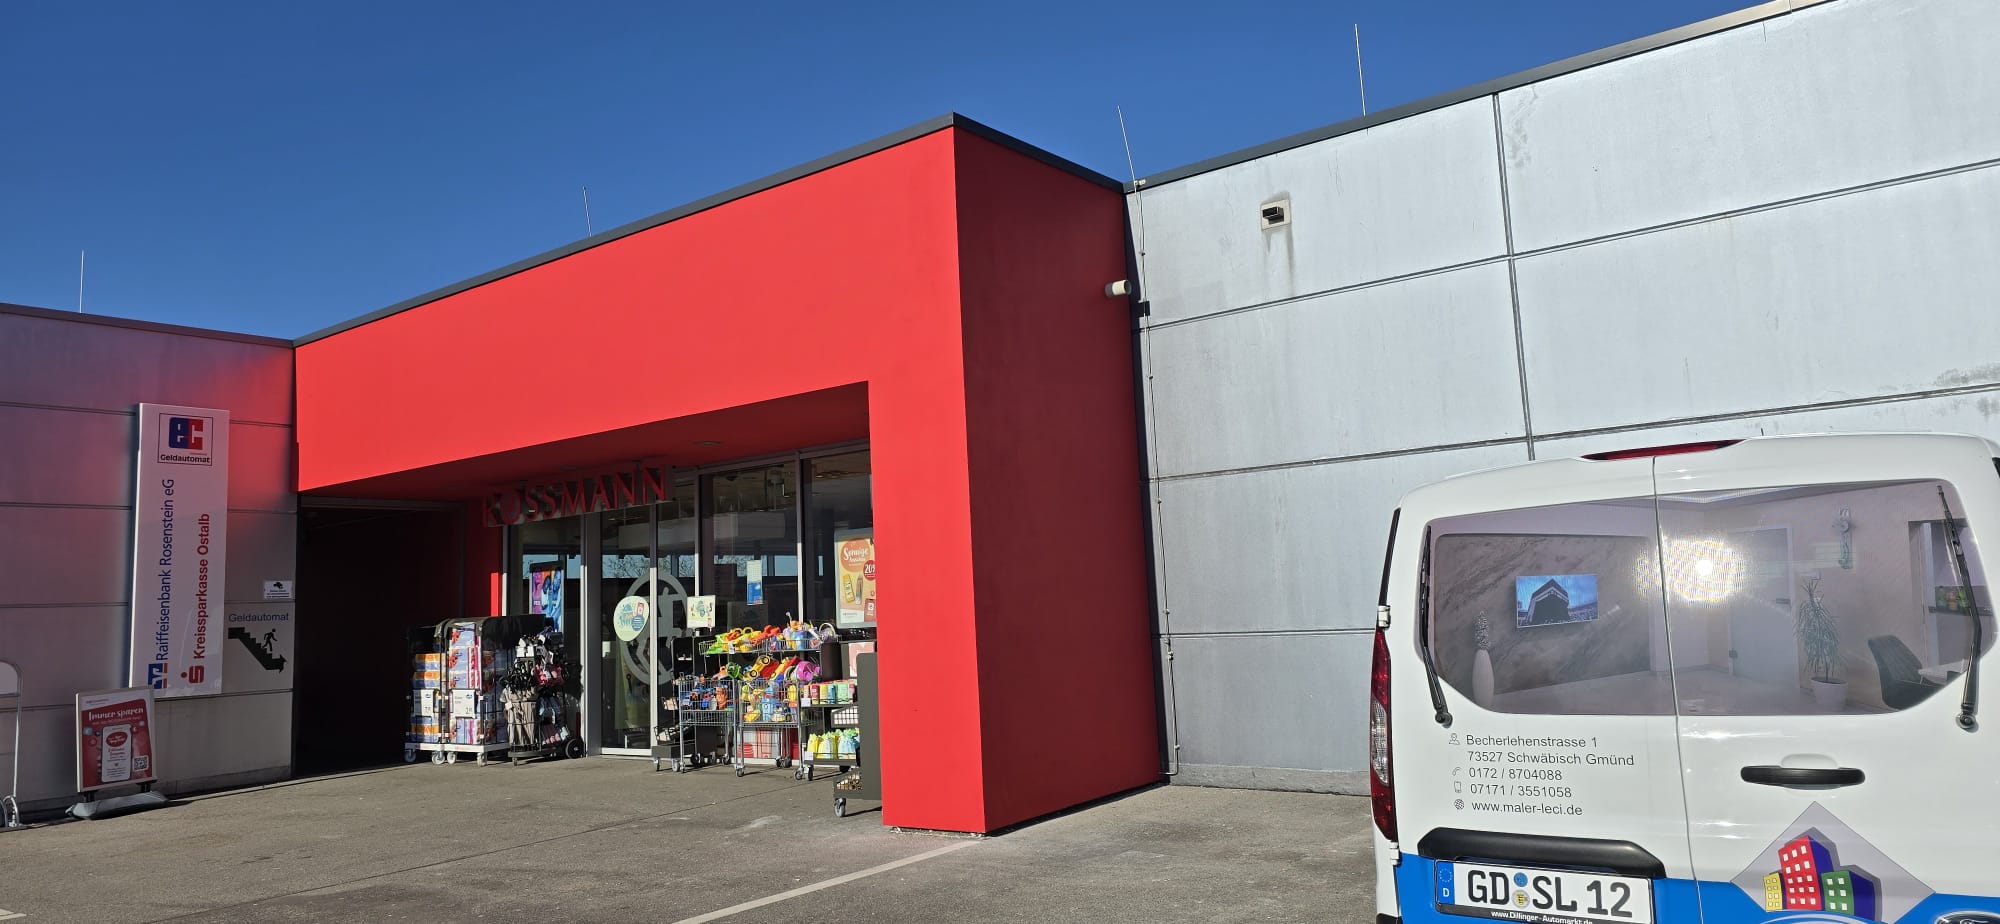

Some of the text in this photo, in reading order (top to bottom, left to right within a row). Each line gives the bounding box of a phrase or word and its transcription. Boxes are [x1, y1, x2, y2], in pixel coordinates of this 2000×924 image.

[160, 454, 210, 464] Geldautomat
[482, 464, 667, 528] ROSSMANN
[155, 479, 175, 661] Raiffeisenbank Rosenstein eG
[193, 513, 210, 659] Kreissparkasse Ostalb
[229, 613, 289, 622] Geldautomat
[1466, 734, 1597, 748] Becherlehenstrasse 1
[1468, 751, 1635, 766] 73527 Schwäbisch Gmünd
[1469, 767, 1498, 779] 0172
[1508, 769, 1562, 781] 8704088
[1470, 784, 1505, 795] 07171
[1517, 786, 1572, 798] 3551058
[1471, 802, 1583, 816] www.maler-leci.de
[1443, 887, 1450, 898] D
[1586, 880, 1633, 918] 12
